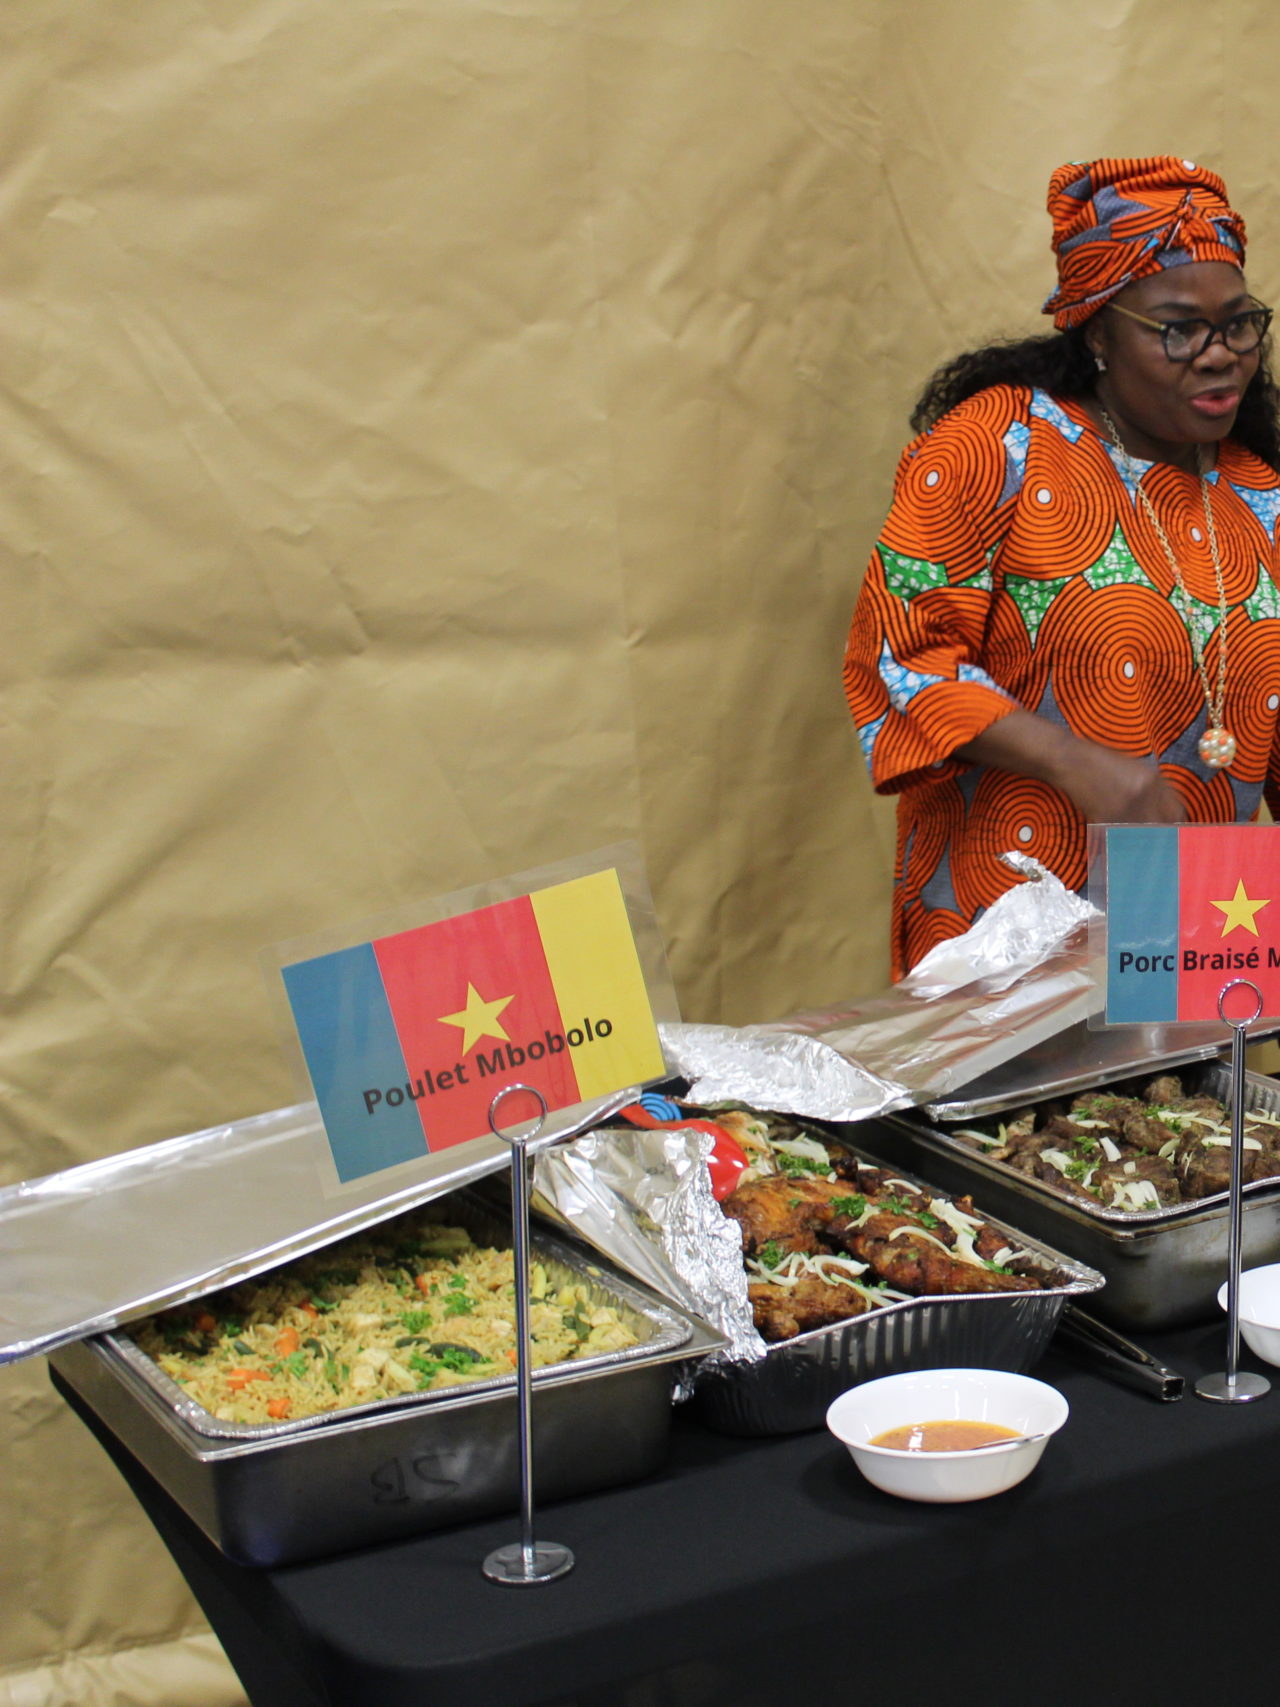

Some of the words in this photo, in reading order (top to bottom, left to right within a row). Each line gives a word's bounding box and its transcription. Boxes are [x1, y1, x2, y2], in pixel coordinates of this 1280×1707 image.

[1119, 951, 1175, 973] Porc
[1183, 946, 1260, 971] Braisé
[362, 1061, 469, 1115] Poulet
[476, 1017, 613, 1078] Mbobolo
